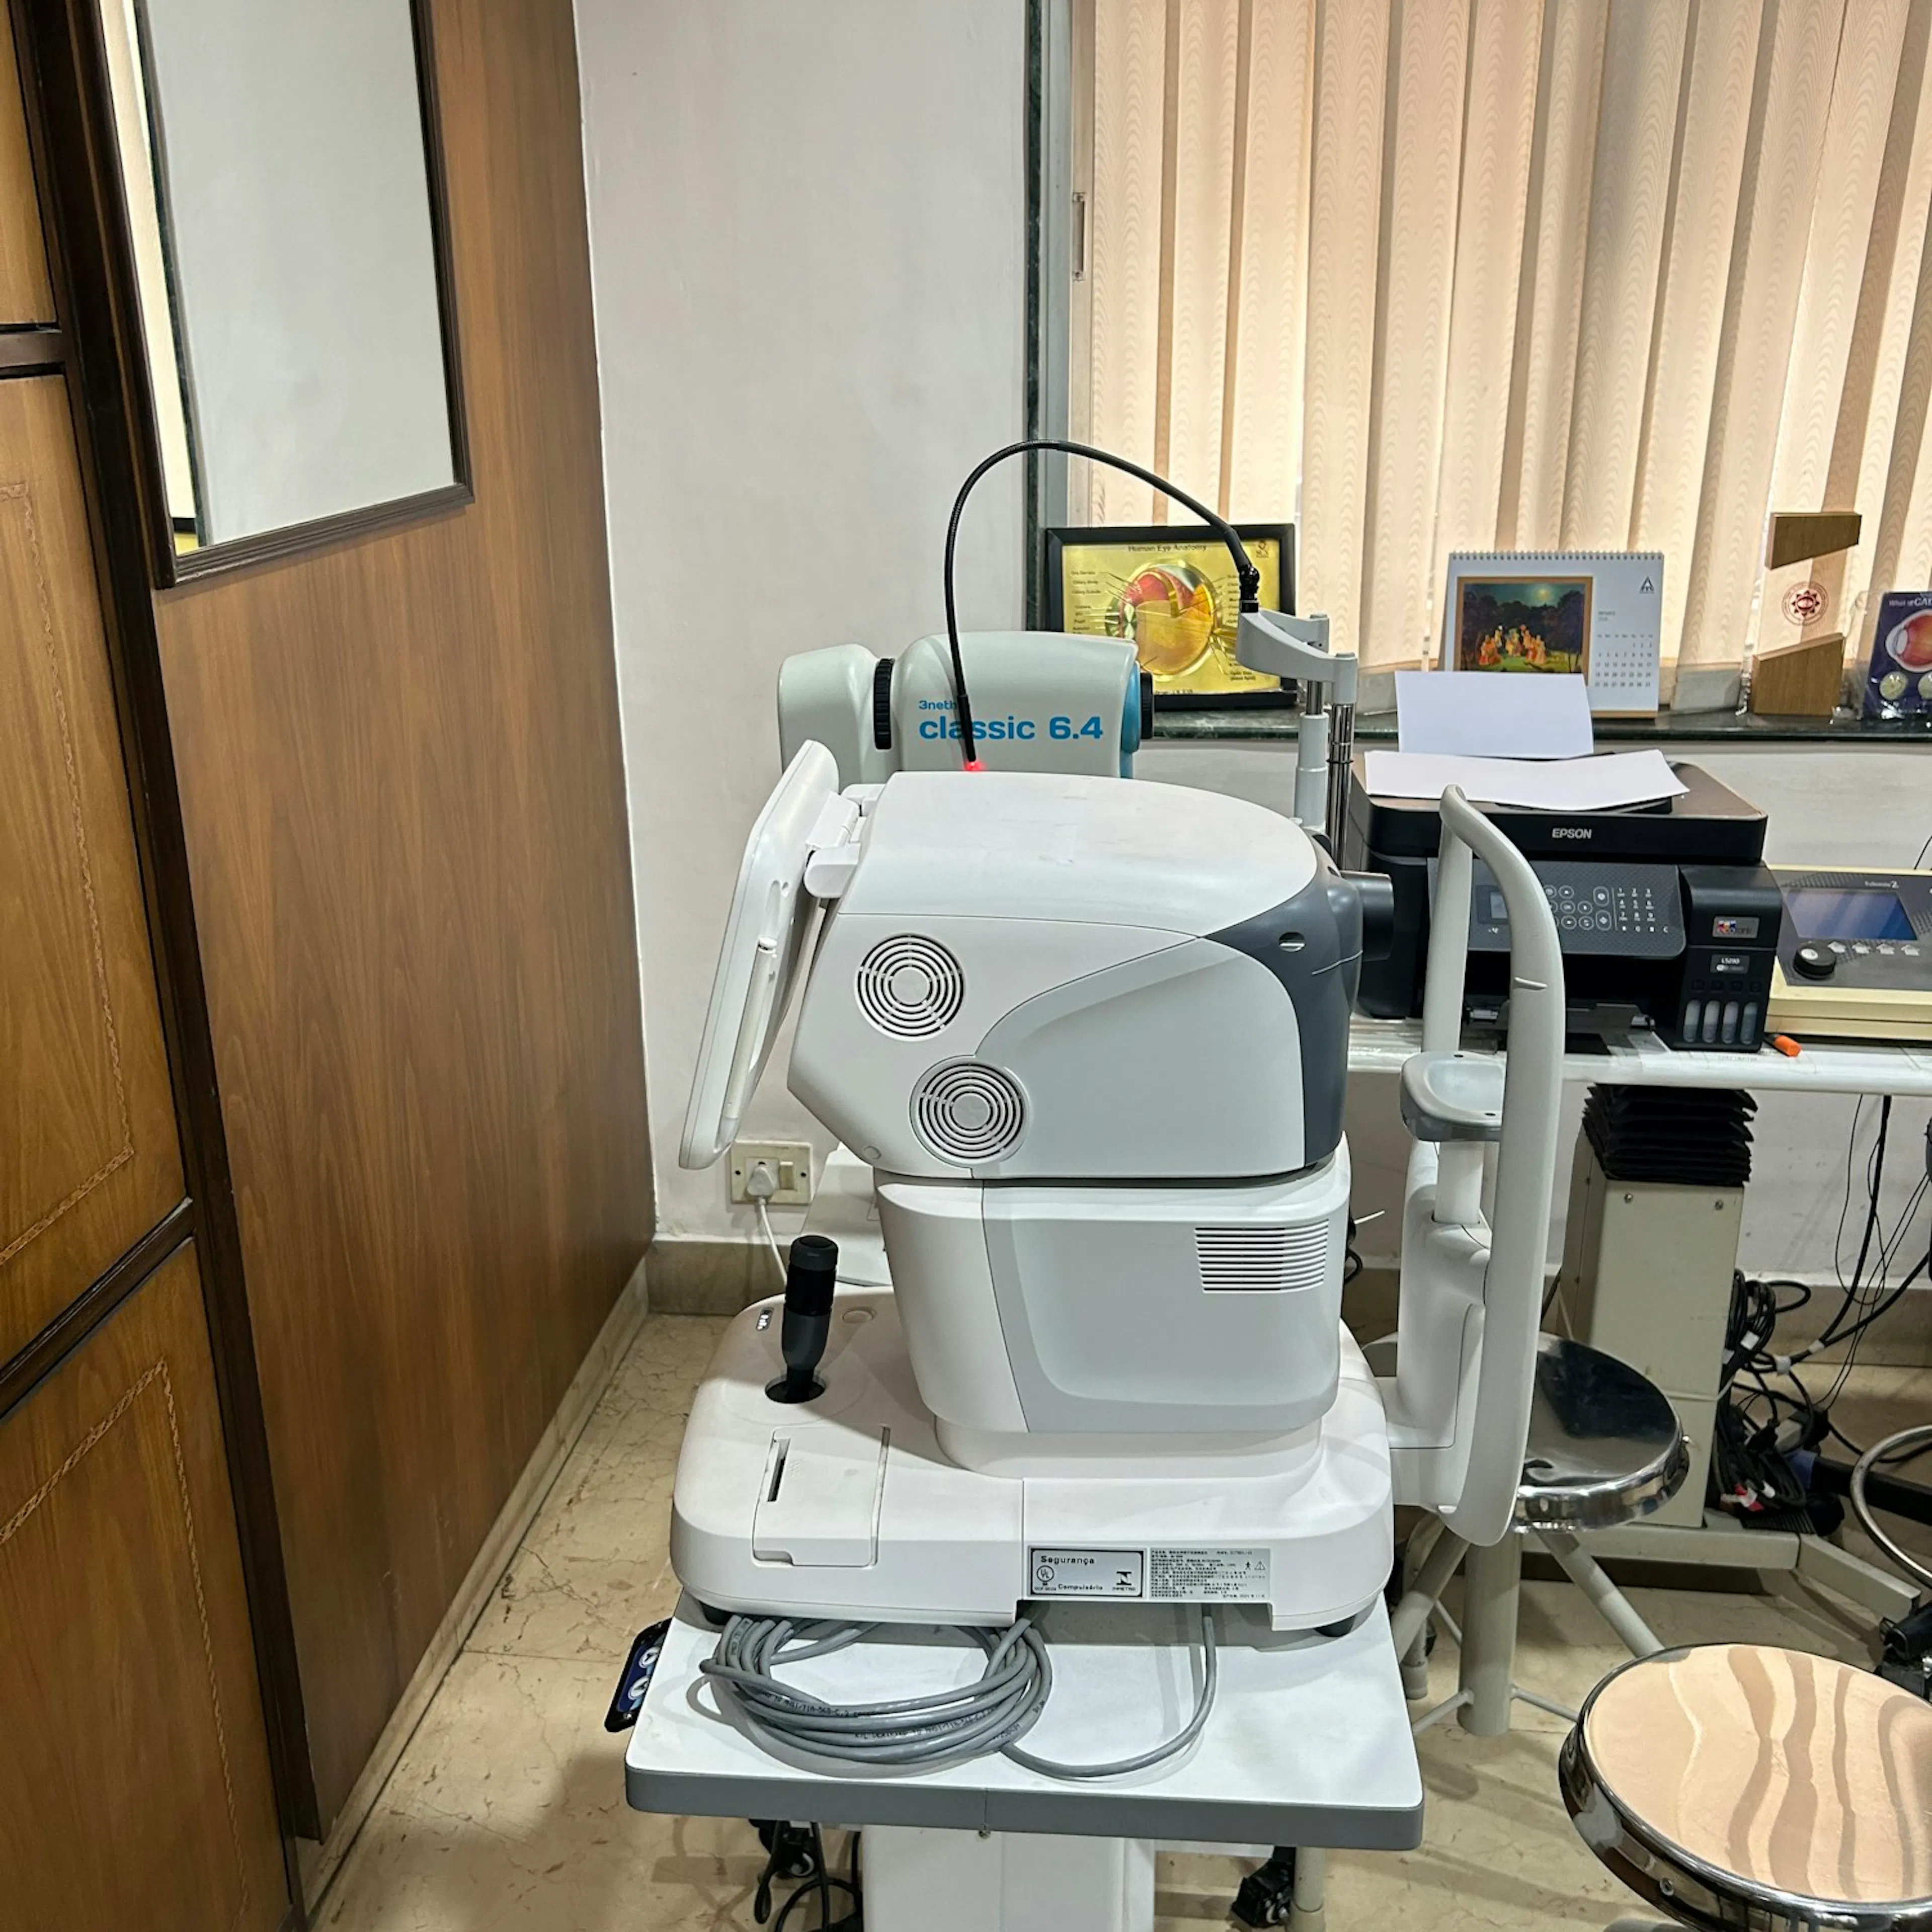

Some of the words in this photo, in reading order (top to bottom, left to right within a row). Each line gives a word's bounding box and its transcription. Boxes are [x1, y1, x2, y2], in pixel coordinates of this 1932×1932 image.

[919, 715, 1035, 740] classic
[1049, 716, 1103, 740] 6.4
[1552, 827, 1593, 840] EPSON
